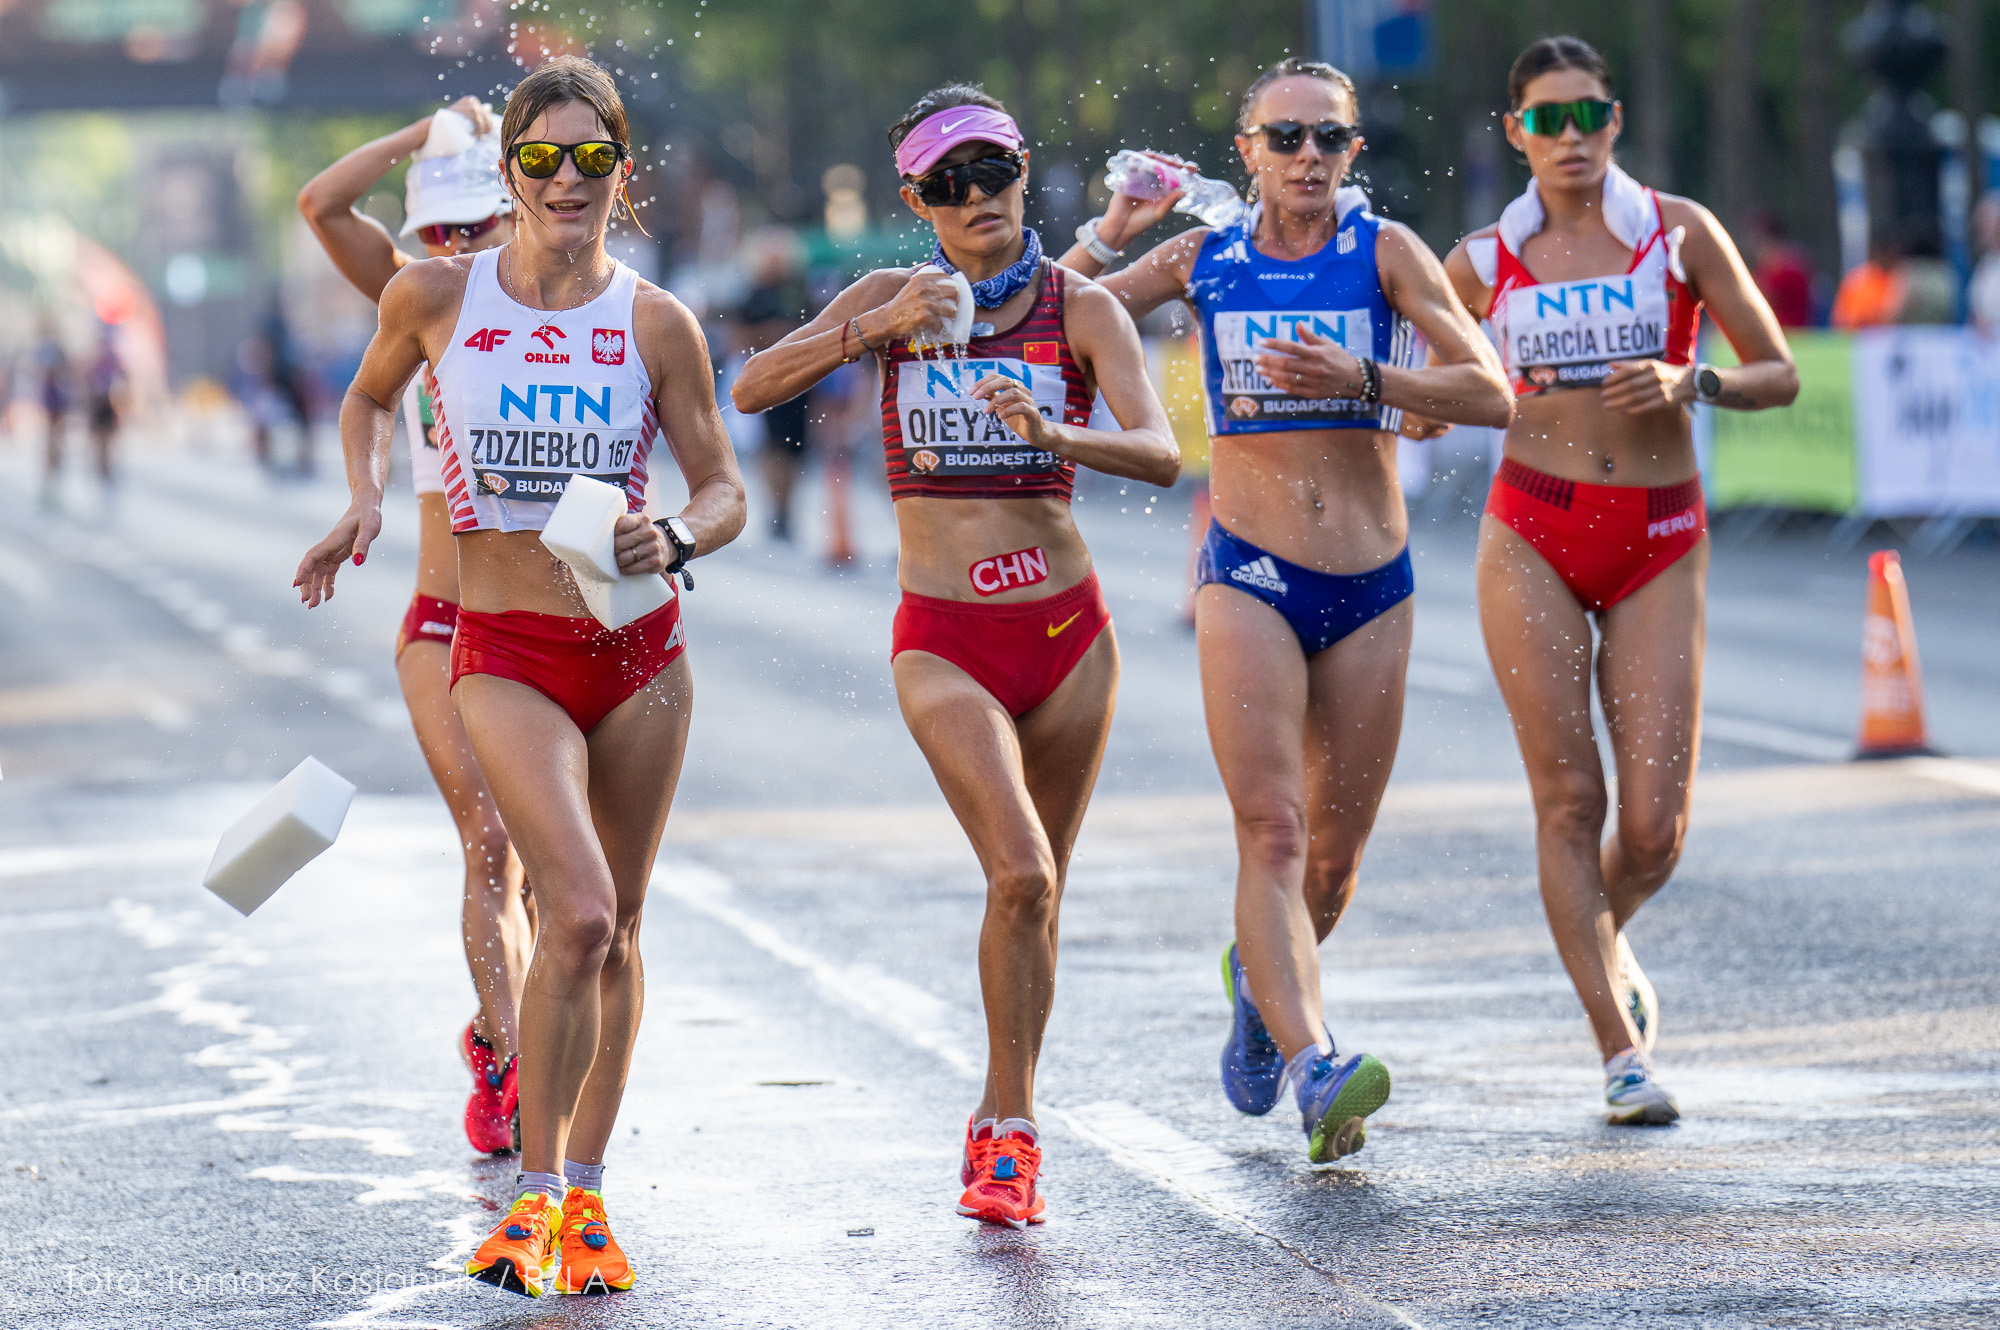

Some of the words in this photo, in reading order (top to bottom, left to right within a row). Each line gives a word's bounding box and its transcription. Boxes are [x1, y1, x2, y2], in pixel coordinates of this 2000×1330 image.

[1257, 272, 1306, 281] AEGEAN
[1536, 280, 1635, 320] NTN
[464, 327, 512, 352] 4F
[1517, 321, 1599, 363] GARCÍA
[1604, 316, 1661, 353] LEÓN
[524, 352, 570, 364] ORLEN
[499, 383, 611, 427] NTN
[1263, 399, 1349, 413] BUDAPEST
[907, 405, 1053, 445] QIEYA
[469, 429, 600, 469] ZDZIEBŁO
[608, 439, 633, 468] 167
[945, 451, 1034, 466] BUDAPEST
[1647, 508, 1697, 539] PERÚ
[972, 547, 1048, 592] CHN
[1230, 569, 1289, 594] adidas
